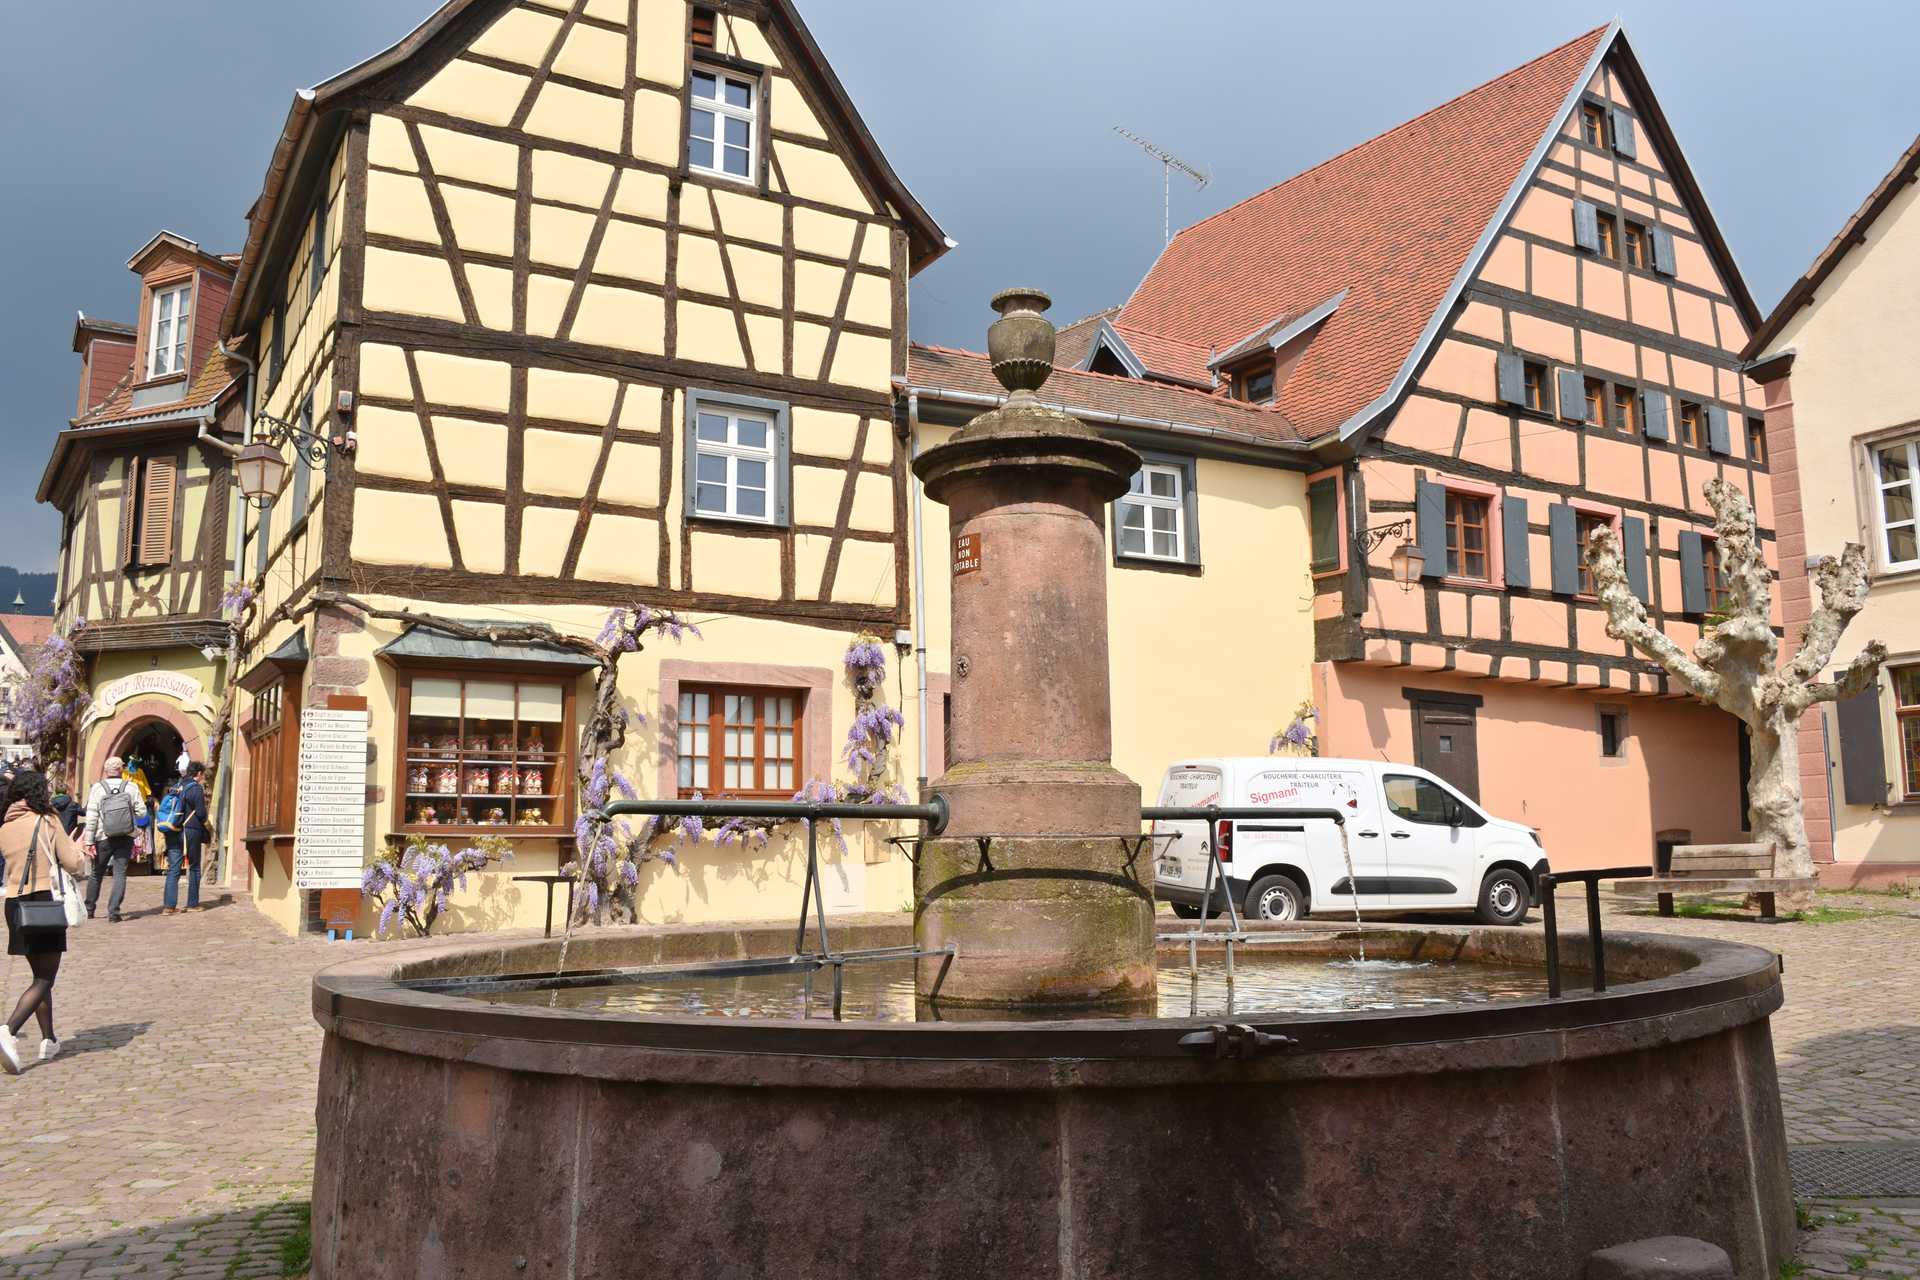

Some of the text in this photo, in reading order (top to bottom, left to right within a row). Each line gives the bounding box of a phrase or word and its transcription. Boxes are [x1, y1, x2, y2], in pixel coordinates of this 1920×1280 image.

[958, 537, 970, 548] EAU
[958, 548, 970, 559] NON
[953, 558, 979, 573] POTABLE
[105, 674, 195, 705] Cour Renaissance
[1250, 787, 1298, 805] Sigmann
